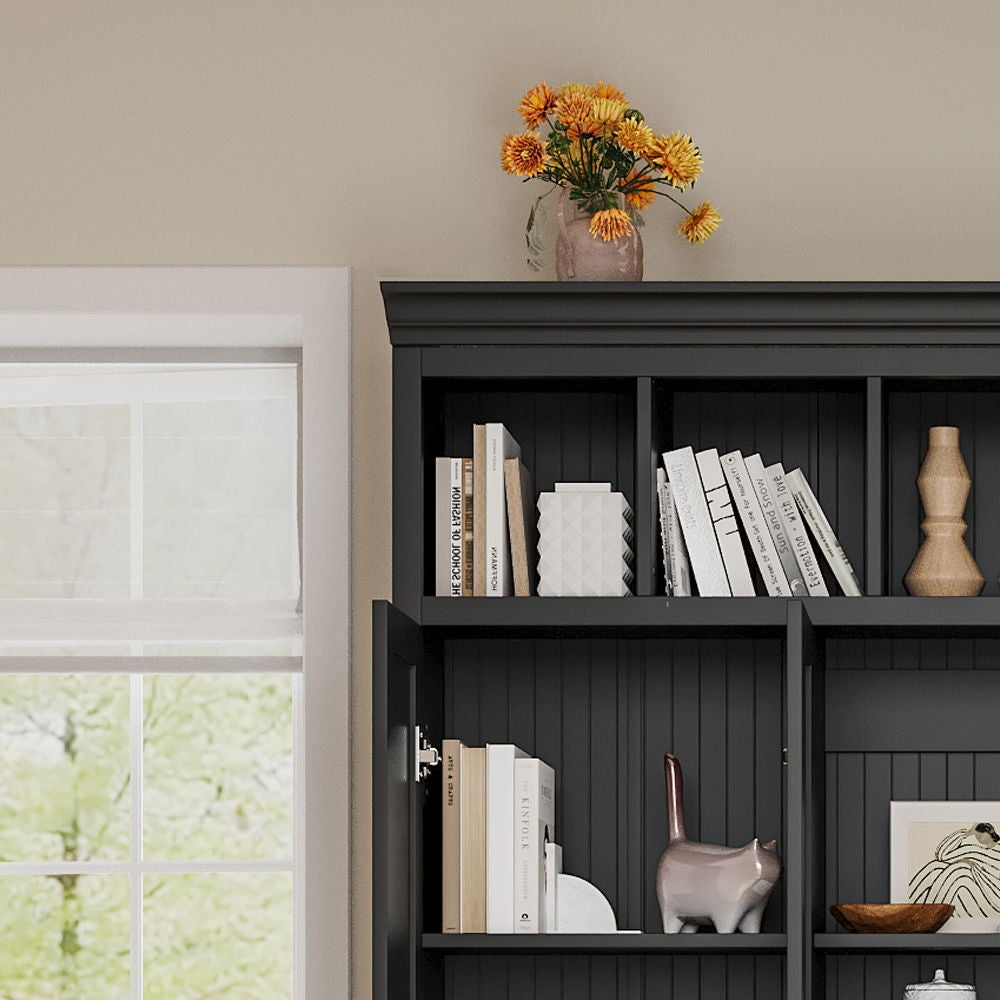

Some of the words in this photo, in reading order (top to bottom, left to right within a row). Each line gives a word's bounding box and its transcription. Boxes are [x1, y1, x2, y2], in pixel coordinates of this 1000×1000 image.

[757, 478, 772, 508] Snow
[773, 476, 786, 497] love
[768, 510, 781, 530] and
[776, 536, 789, 554] Sun
[795, 536, 821, 588] Evermotion
[521, 798, 530, 850] KINFOLK
